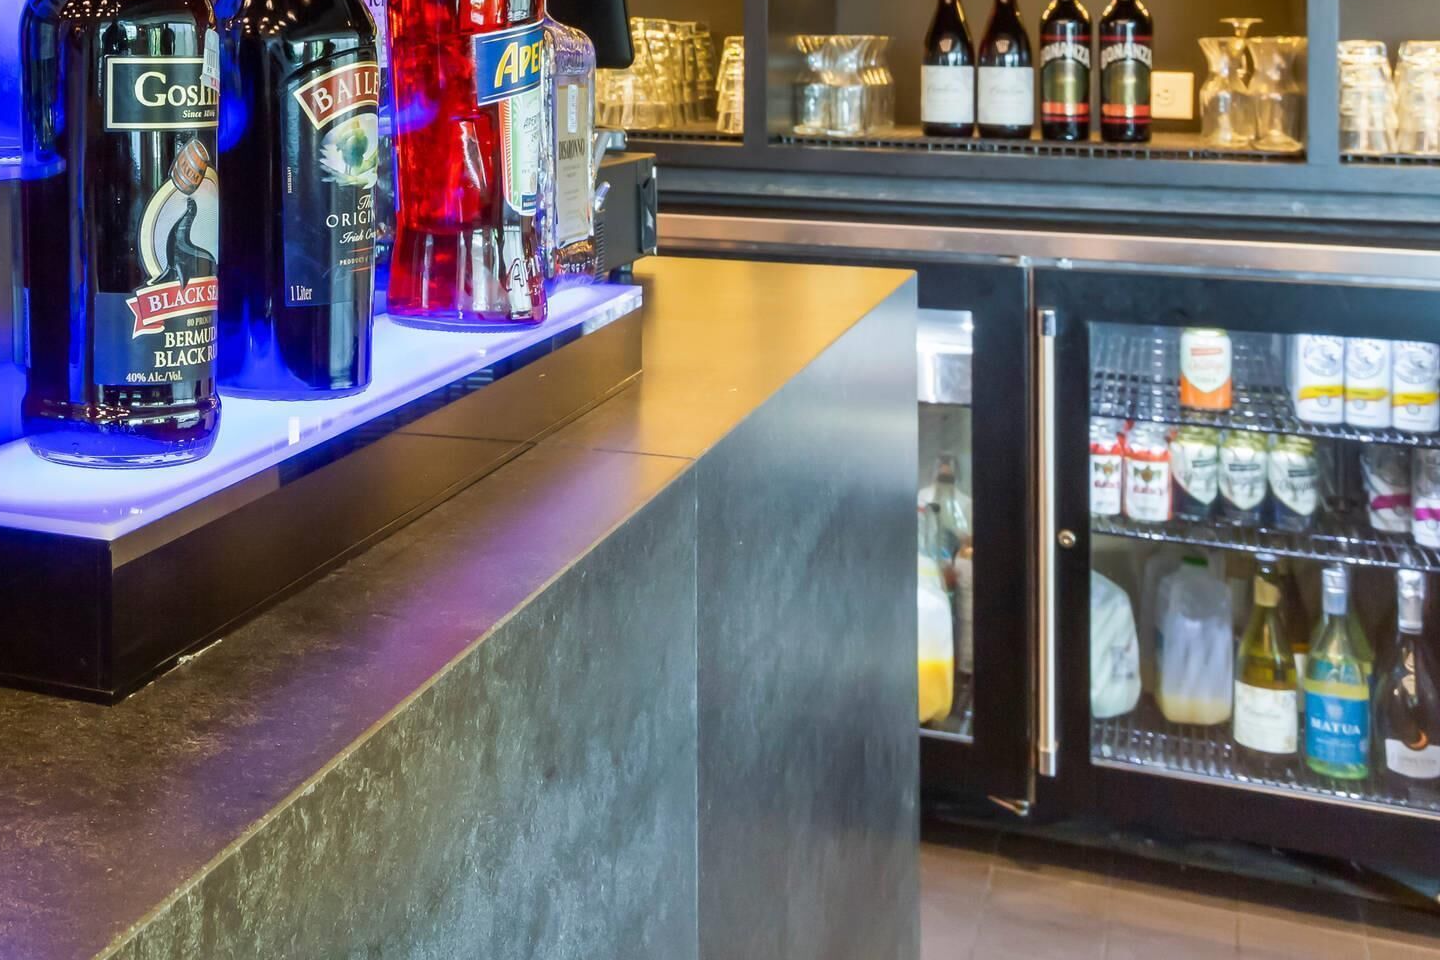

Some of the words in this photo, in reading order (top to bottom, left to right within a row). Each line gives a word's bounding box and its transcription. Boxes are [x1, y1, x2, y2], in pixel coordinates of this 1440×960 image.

[494, 41, 542, 88] APE
[1041, 42, 1091, 69] BONANZA
[1101, 42, 1152, 69] BONANZA
[311, 71, 378, 113] BAILE
[182, 109, 202, 118] Since
[181, 159, 201, 184] RUM
[326, 210, 375, 228] ORIGIN
[340, 231, 363, 244] Irish
[148, 286, 205, 313] BLACK
[296, 285, 312, 300] Liter
[164, 326, 216, 348] BERMUD
[154, 349, 206, 368] BLACK
[207, 344, 217, 362] RU
[126, 372, 146, 383] 40%
[148, 371, 183, 382] Alc./Vol.
[1311, 717, 1361, 736] MATUA
